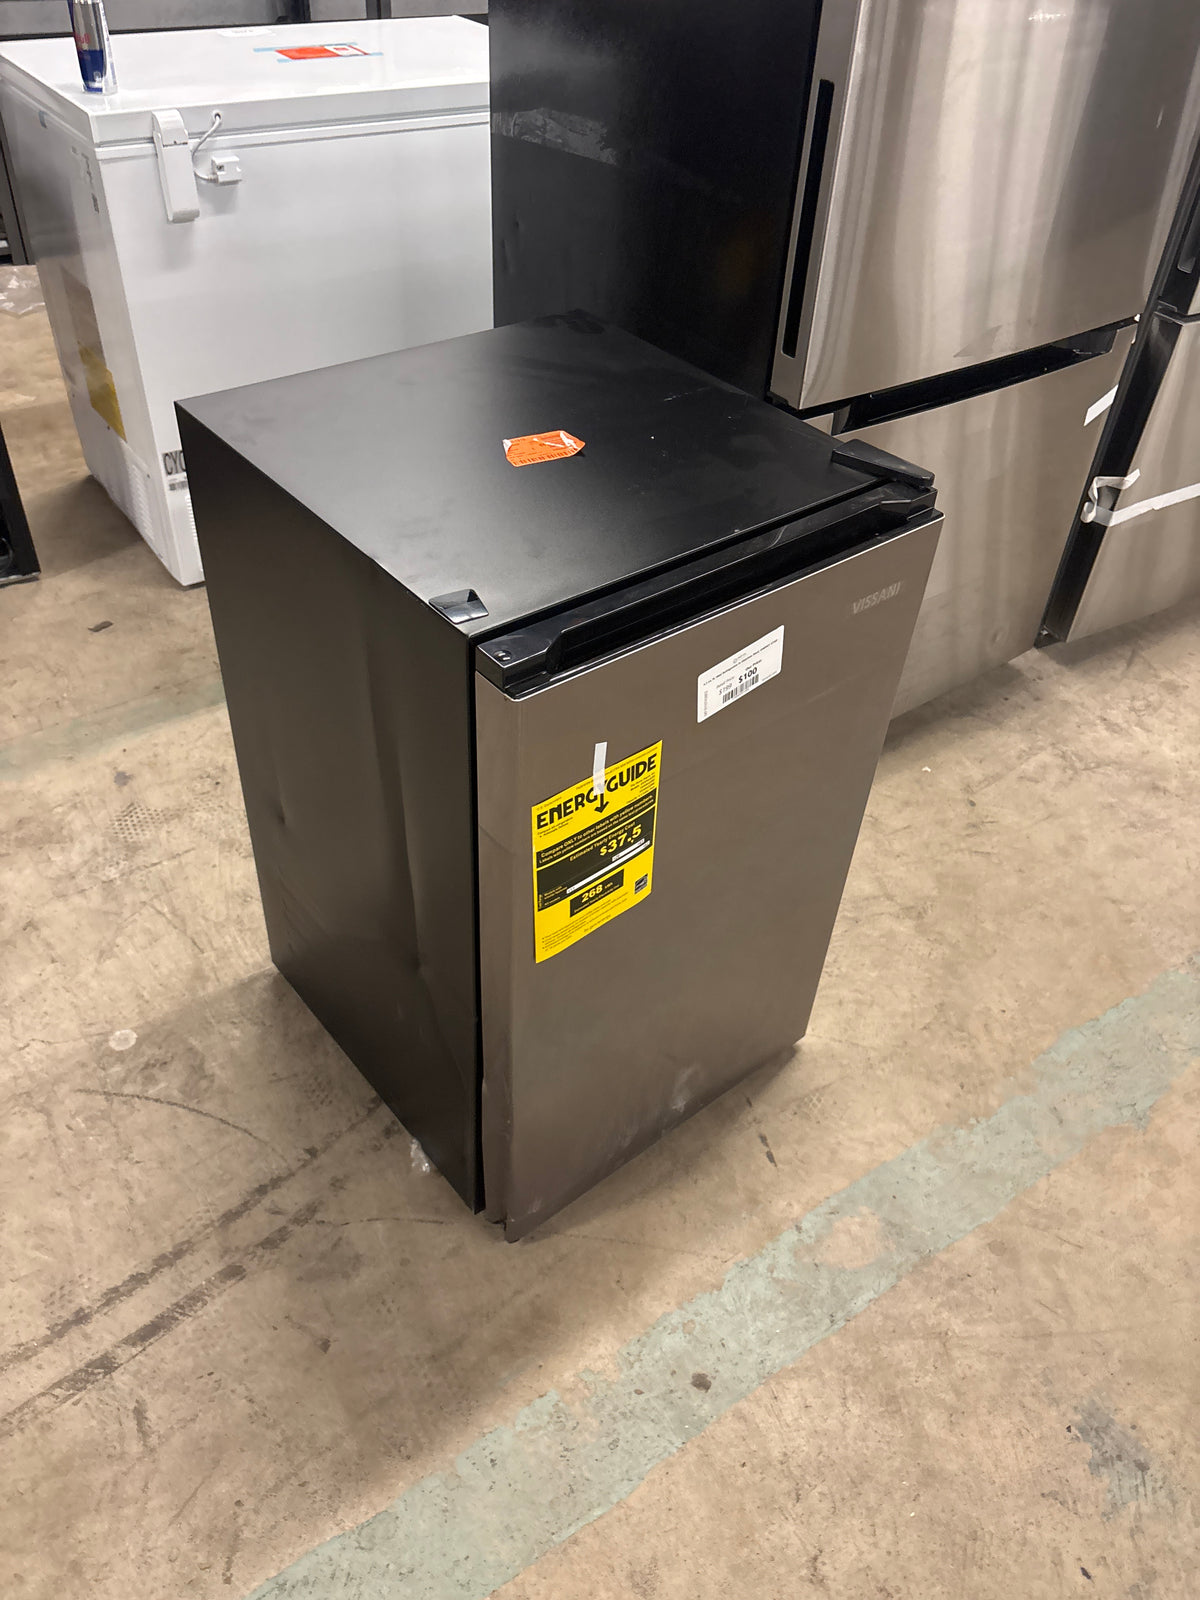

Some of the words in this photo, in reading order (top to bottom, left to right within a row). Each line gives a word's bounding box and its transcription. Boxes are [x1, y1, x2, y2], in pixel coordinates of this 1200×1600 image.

[852, 581, 901, 614] VISSANI
[738, 666, 758, 684] $100
[536, 753, 657, 830] ENERGGUIDE
[541, 846, 562, 858] Compare
[564, 837, 576, 847] ONLY
[569, 846, 592, 860] Estimated
[593, 838, 607, 847] Yearly
[608, 830, 623, 839] Energy
[624, 821, 635, 829] Cost
[600, 824, 642, 856] $37.5
[581, 884, 603, 903] 268
